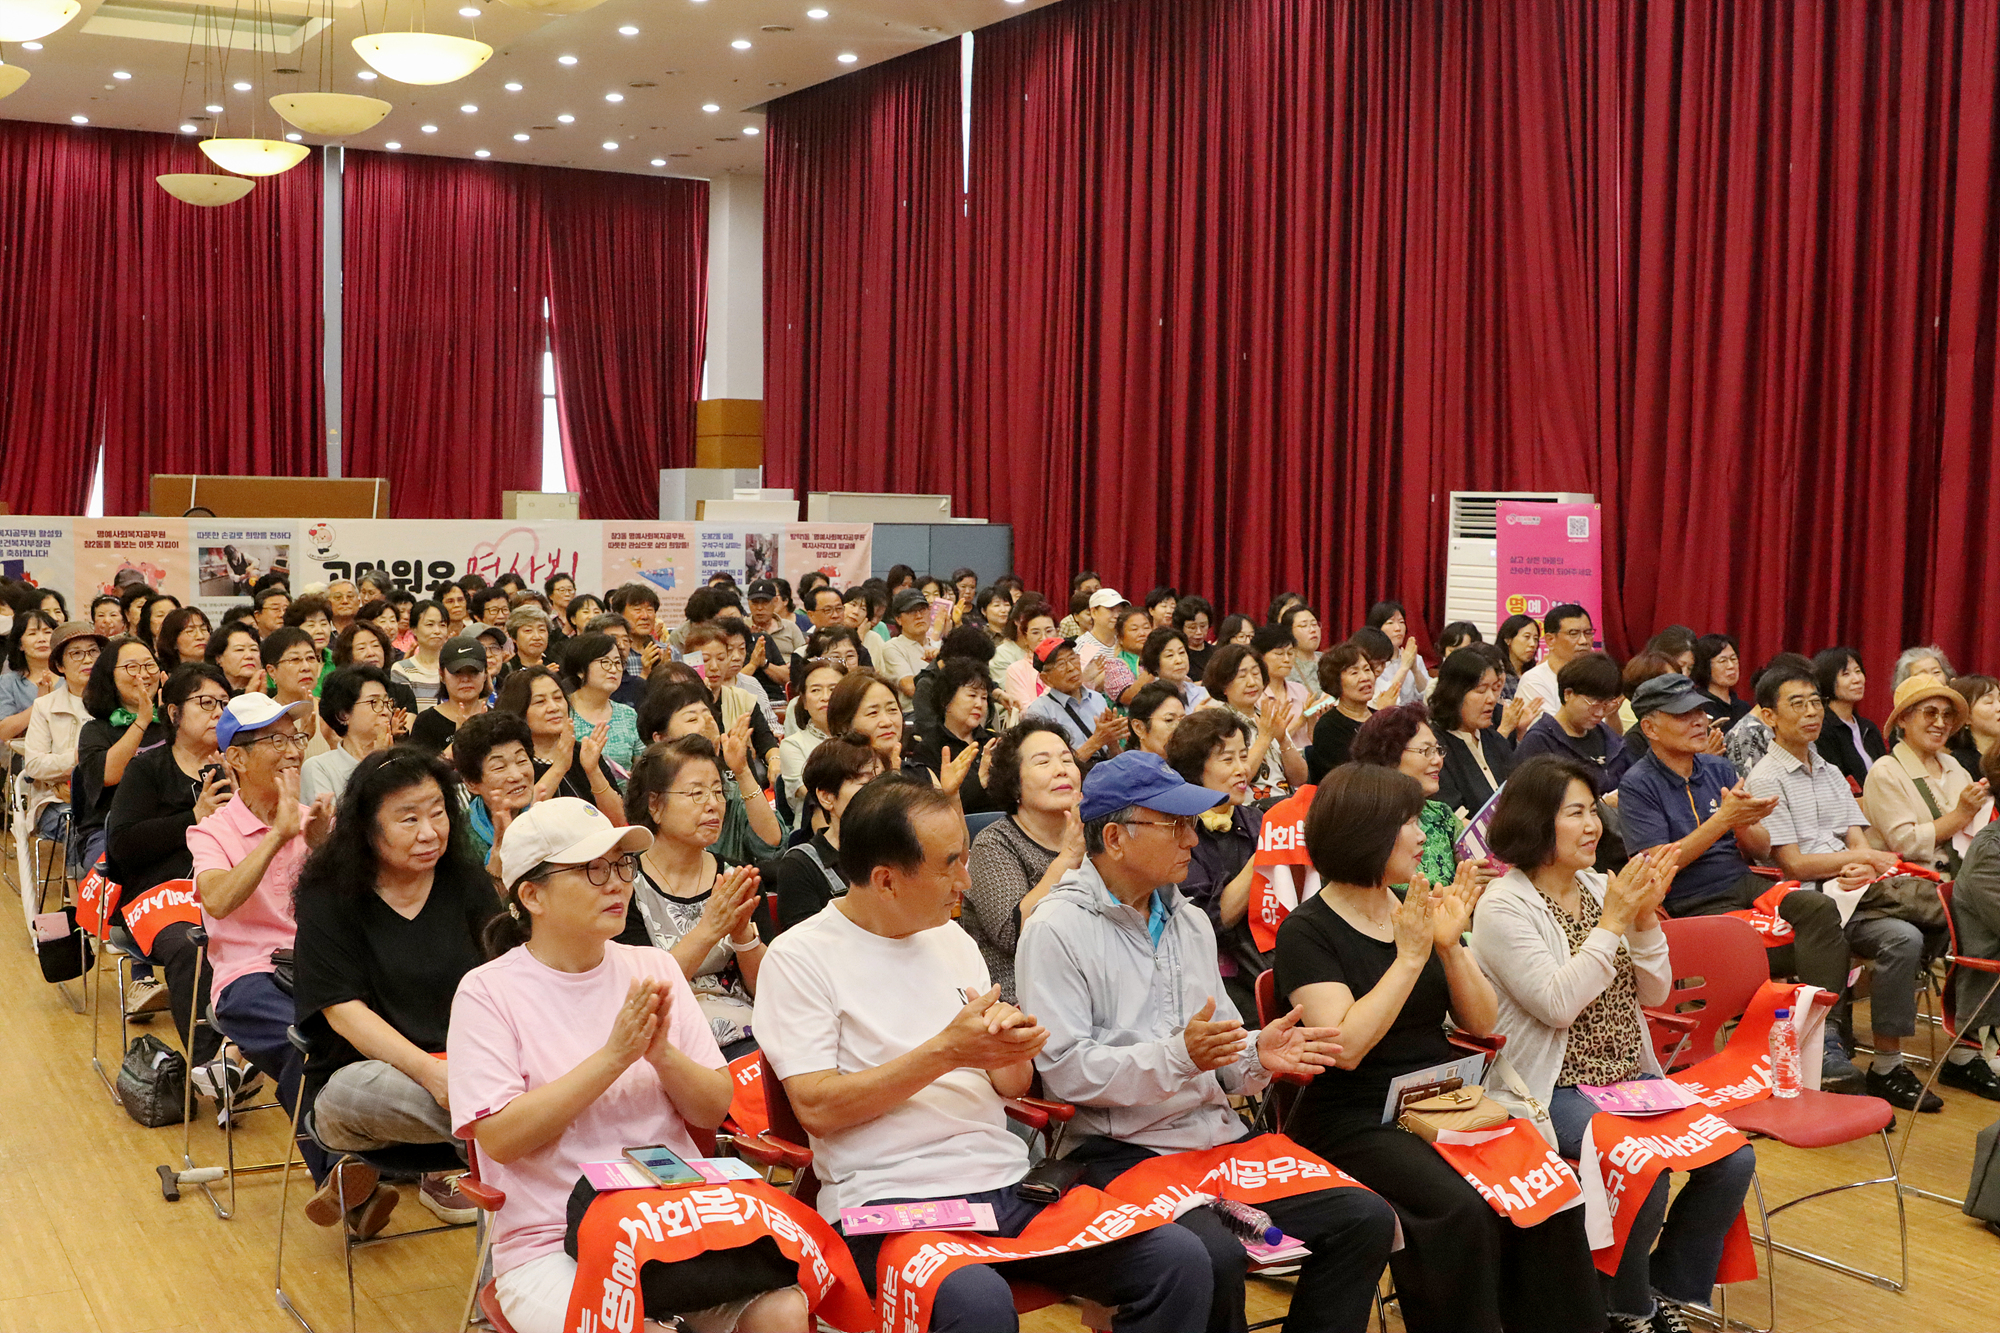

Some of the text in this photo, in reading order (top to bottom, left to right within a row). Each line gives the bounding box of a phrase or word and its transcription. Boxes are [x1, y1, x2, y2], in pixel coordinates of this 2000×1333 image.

[38, 529, 63, 538] 활성화
[96, 530, 166, 539] 명예사회복지공무원
[196, 531, 291, 540] 따뜻한 손길로 희망을 전하다
[610, 532, 627, 540] 창3동
[83, 540, 179, 549] 창2동을 돌보는 이웃 지킴이
[607, 541, 627, 549] 따뜻한
[628, 541, 653, 549] 관심으로
[801, 542, 837, 550] 복지사각지대
[6, 549, 49, 558] 축하합니다!
[1509, 597, 1542, 614] 명예
